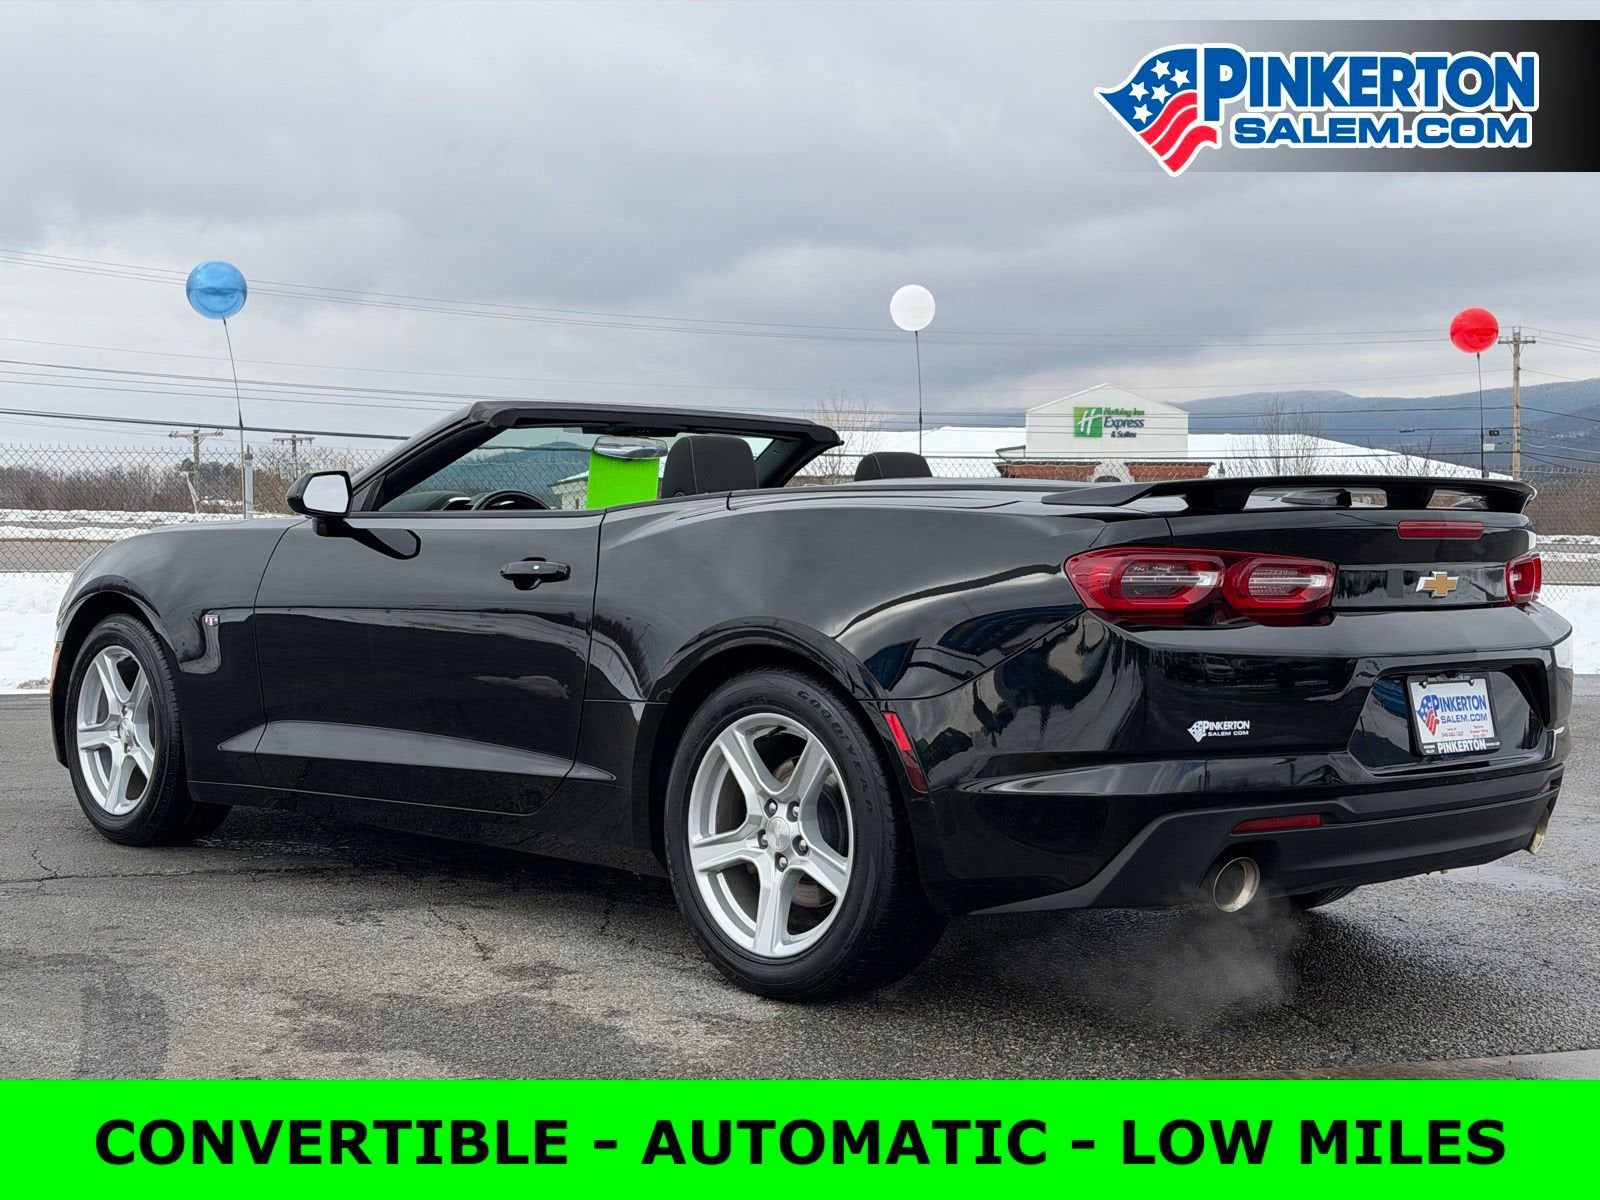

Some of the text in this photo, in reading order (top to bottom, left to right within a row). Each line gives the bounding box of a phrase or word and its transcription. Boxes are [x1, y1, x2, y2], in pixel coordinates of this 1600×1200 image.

[1104, 416, 1145, 431] Express
[1117, 430, 1137, 438] Suites
[1431, 694, 1487, 717] PINKERTON
[1203, 720, 1251, 733] PINKERTON
[1437, 738, 1487, 754] PINKERTON
